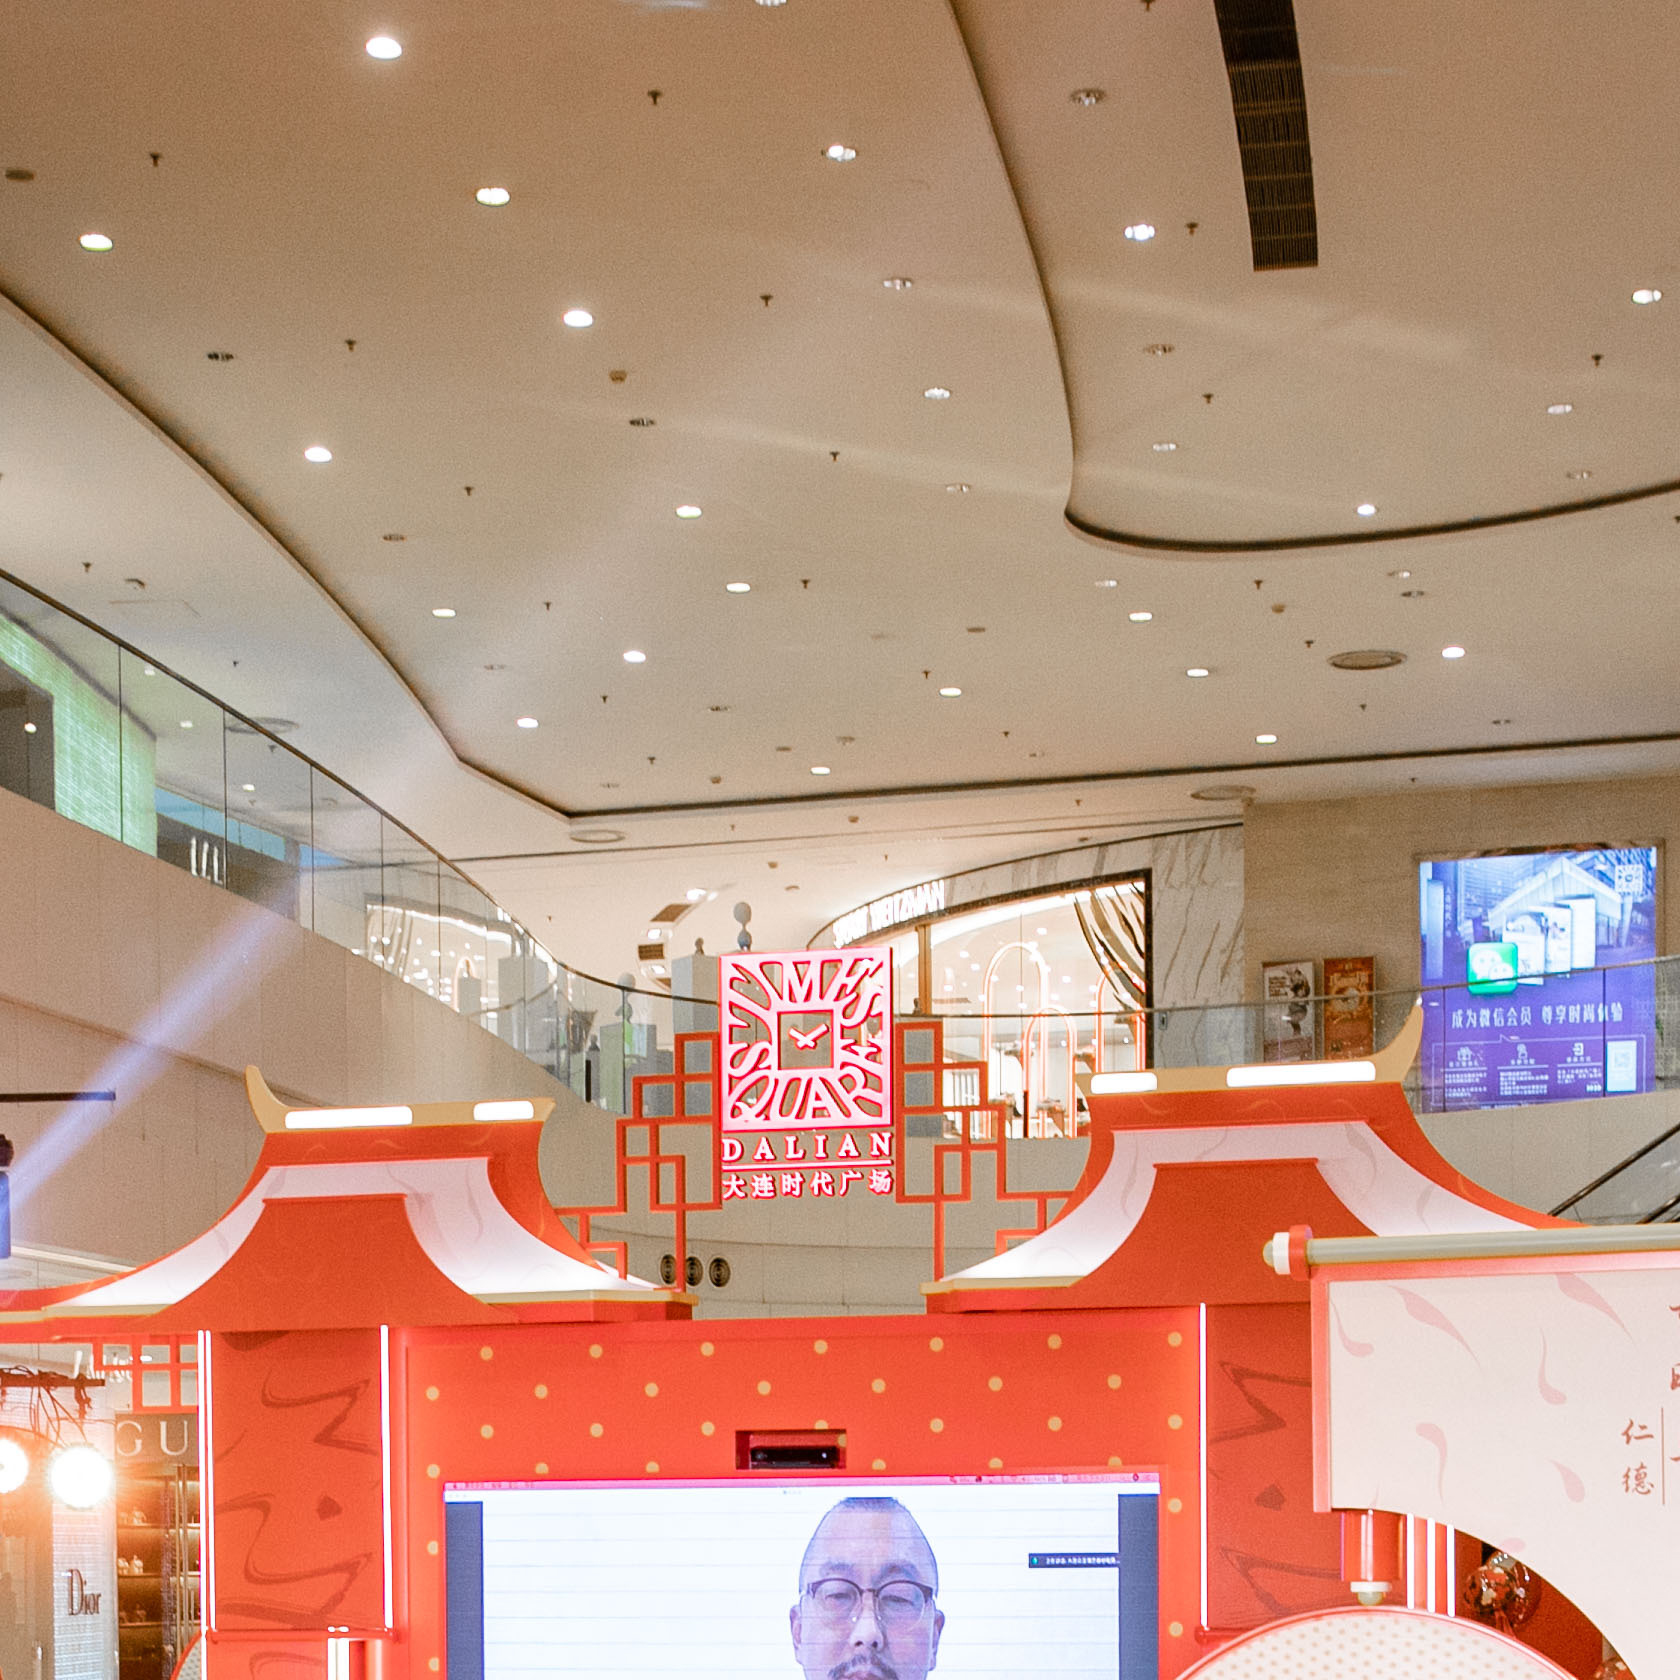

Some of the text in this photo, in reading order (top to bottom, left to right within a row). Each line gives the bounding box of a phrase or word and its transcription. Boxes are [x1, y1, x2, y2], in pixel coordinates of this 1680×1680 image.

[1451, 1006, 1532, 1030] 成为微信会员
[720, 1131, 894, 1163] DALIAN
[721, 1168, 894, 1200] 大连时代广场
[1621, 1418, 1655, 1496] 仁德
[67, 1568, 102, 1616] Dior
